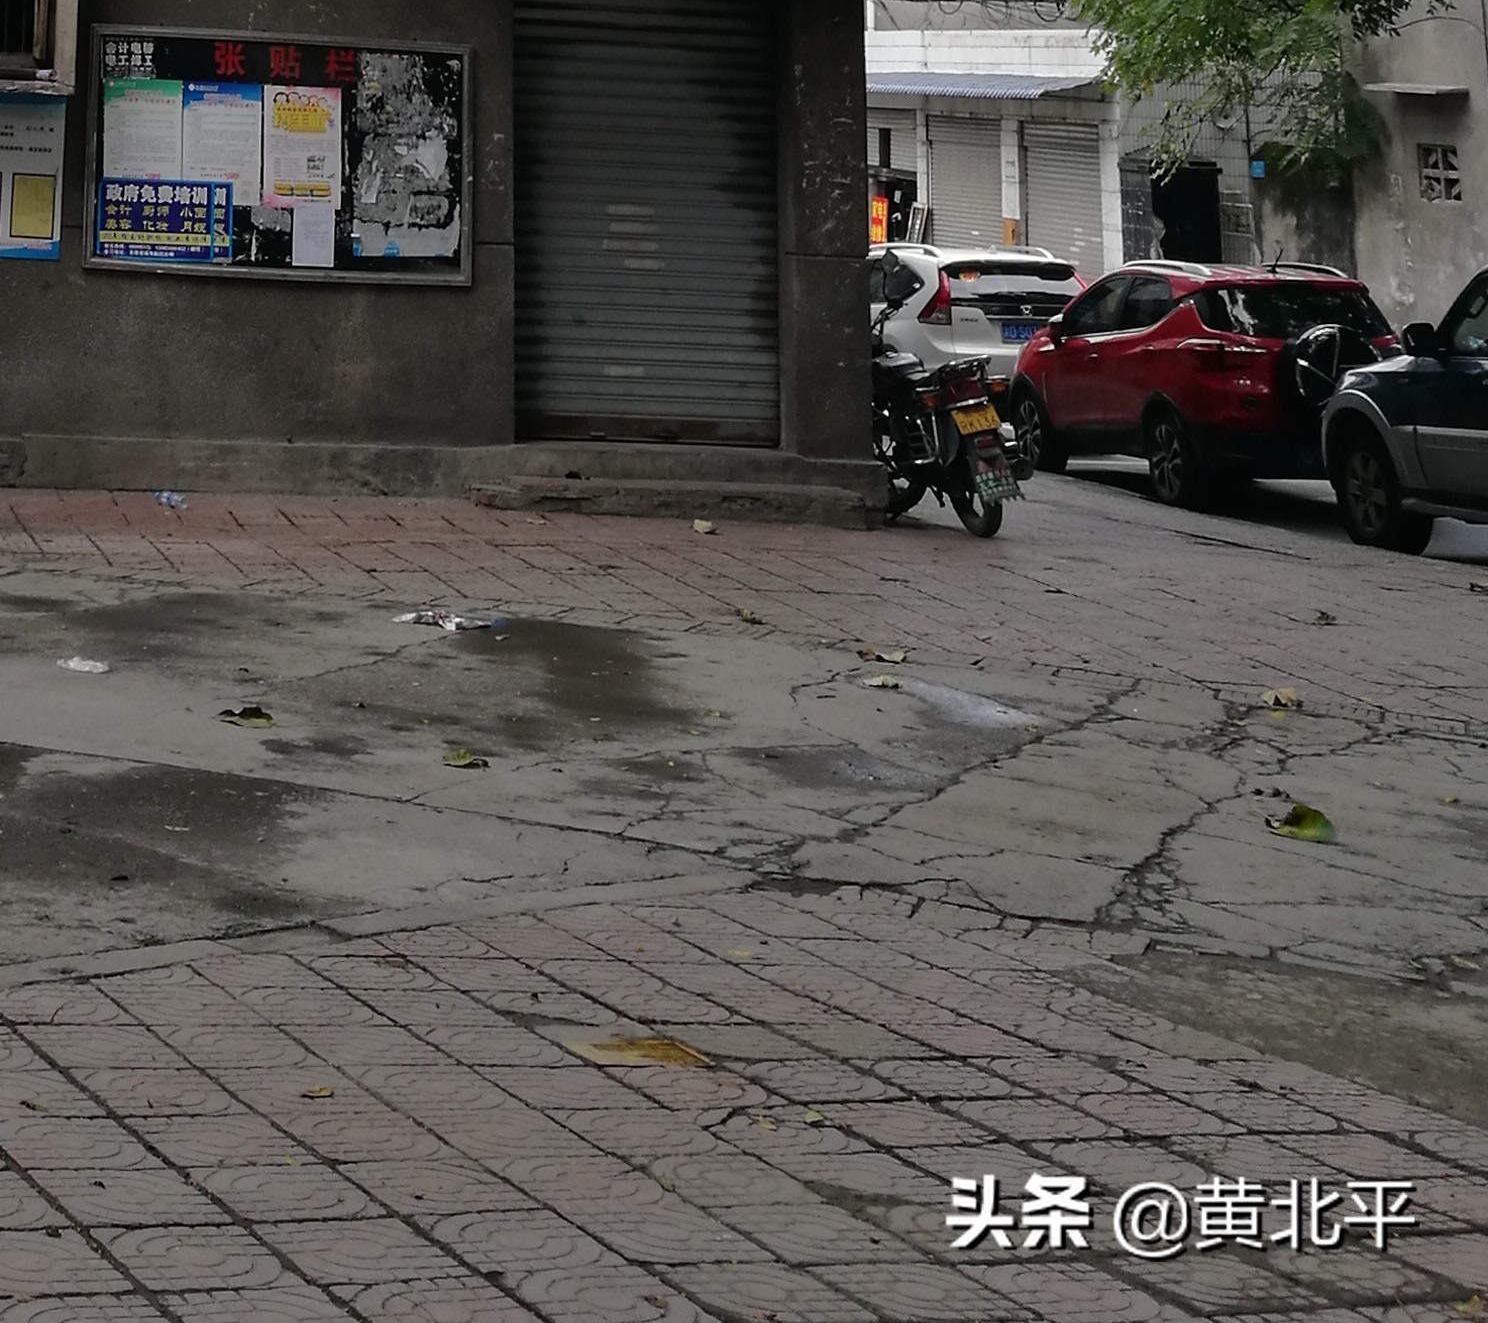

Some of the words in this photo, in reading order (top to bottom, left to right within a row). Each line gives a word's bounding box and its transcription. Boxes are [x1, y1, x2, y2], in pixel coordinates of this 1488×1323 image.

[212, 41, 358, 83] 张贴栏
[106, 184, 209, 205] 政府免费培训
